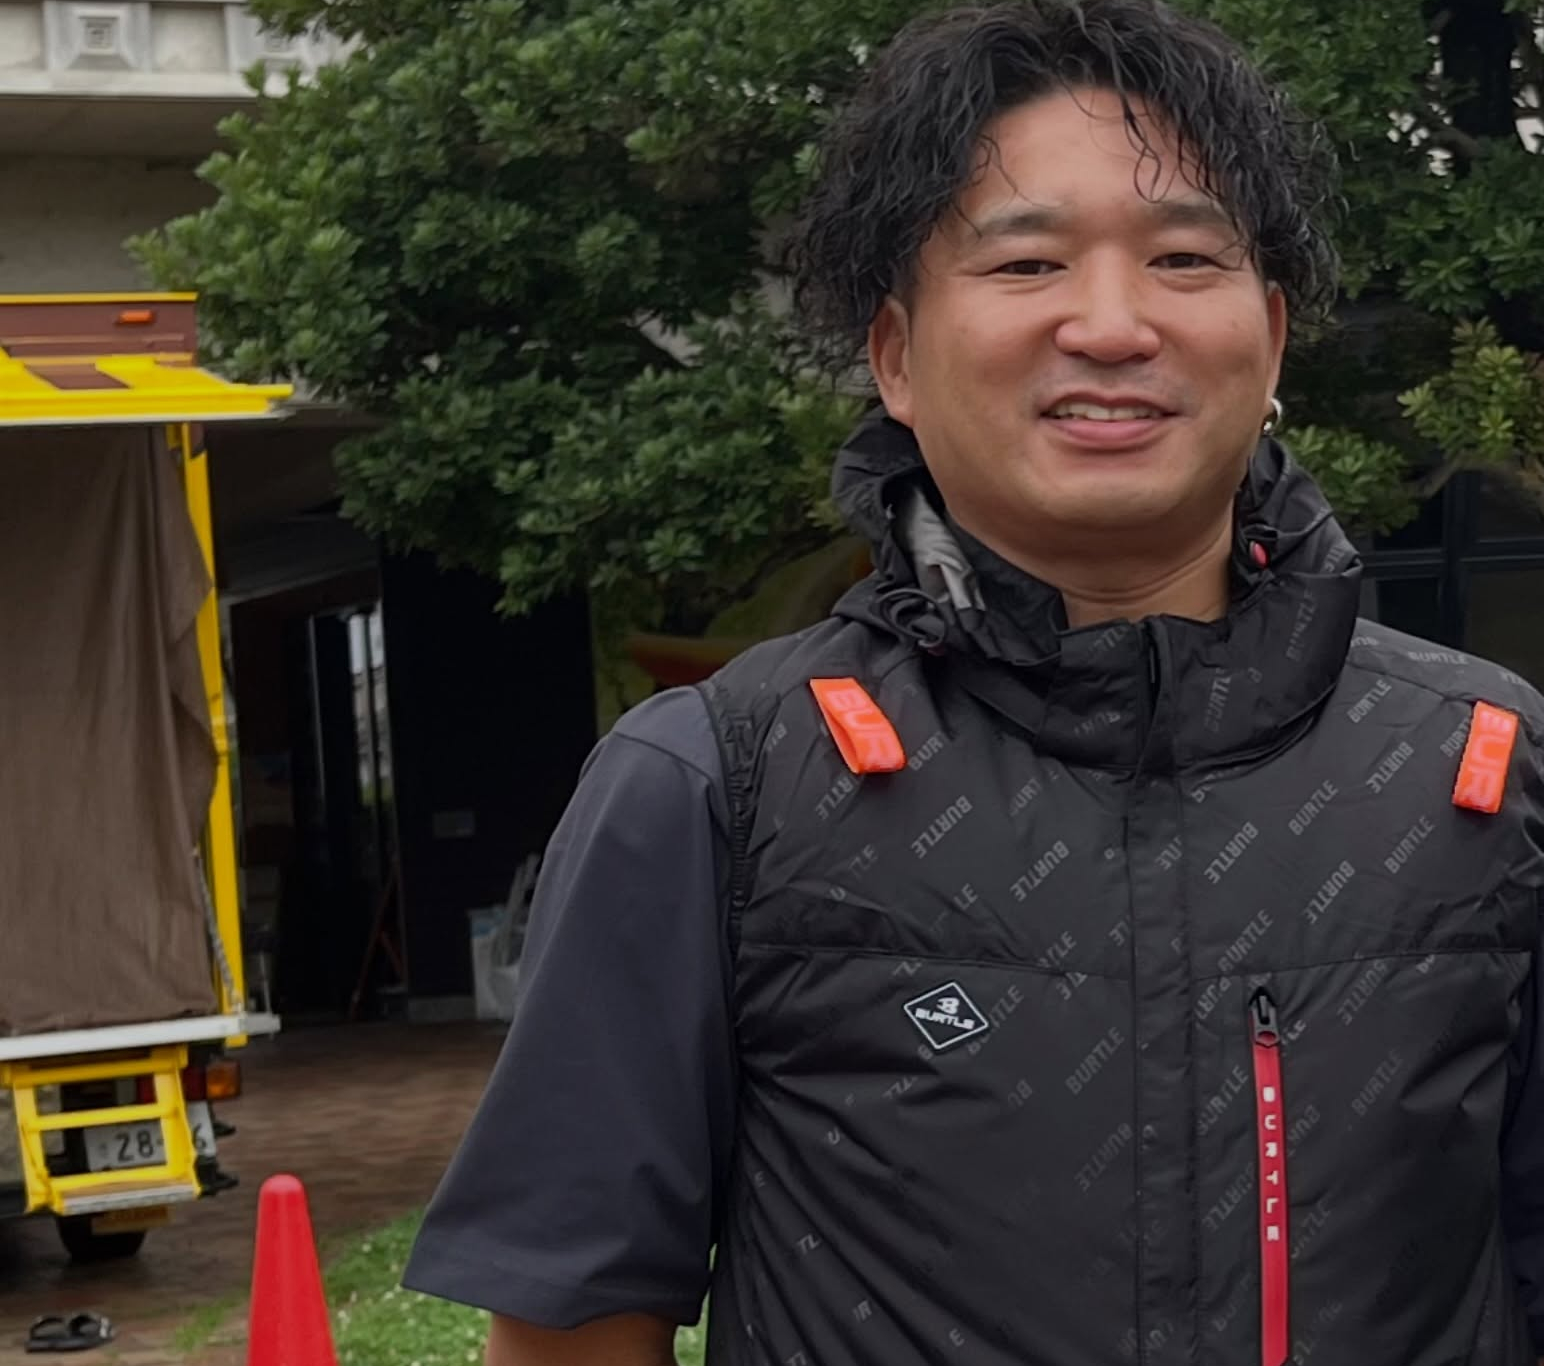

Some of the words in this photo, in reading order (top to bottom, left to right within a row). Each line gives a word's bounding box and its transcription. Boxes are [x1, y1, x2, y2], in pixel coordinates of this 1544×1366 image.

[1346, 679, 1392, 724] BURTLE
[1365, 740, 1415, 794] BURTLE
[910, 795, 973, 859] BURTLE
[1287, 779, 1340, 835] BURTLE
[1009, 839, 1070, 902] BURTLE
[1203, 820, 1260, 884] BURTLE
[1383, 816, 1435, 874] BURTLE
[1300, 859, 1356, 925] BURTLE
[916, 1007, 975, 1030] BURTLE
[1065, 1027, 1125, 1096] BURTLE
[1352, 1048, 1402, 1117] BURTLE
[1073, 1123, 1133, 1192] BURTLE
[1263, 1086, 1280, 1241] BURTLE
